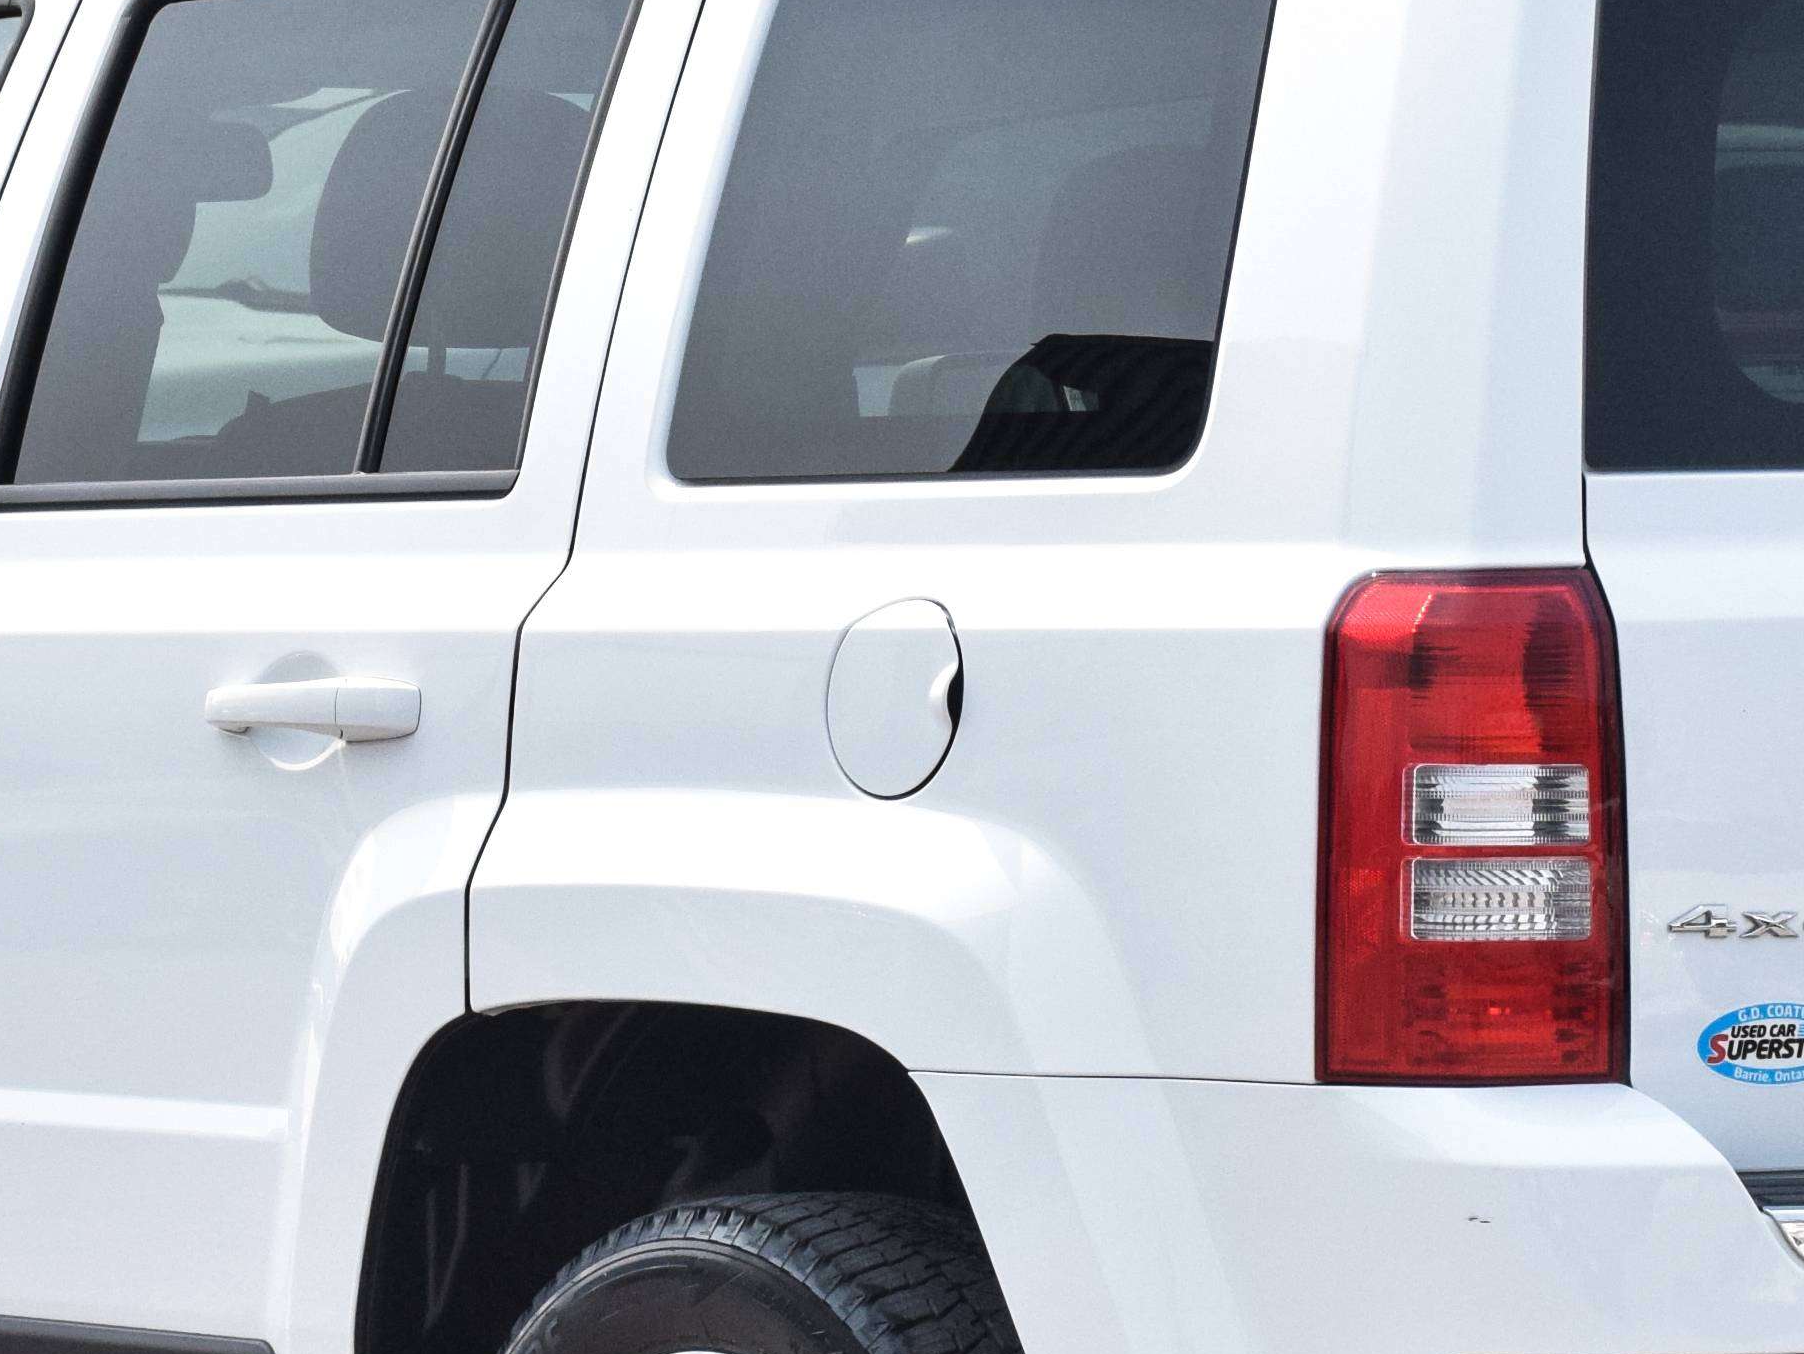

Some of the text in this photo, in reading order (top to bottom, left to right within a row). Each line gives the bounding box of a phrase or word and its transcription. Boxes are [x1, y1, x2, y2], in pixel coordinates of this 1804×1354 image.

[1738, 1007, 1764, 1022] G.D.
[1731, 1024, 1796, 1038] USED CAR
